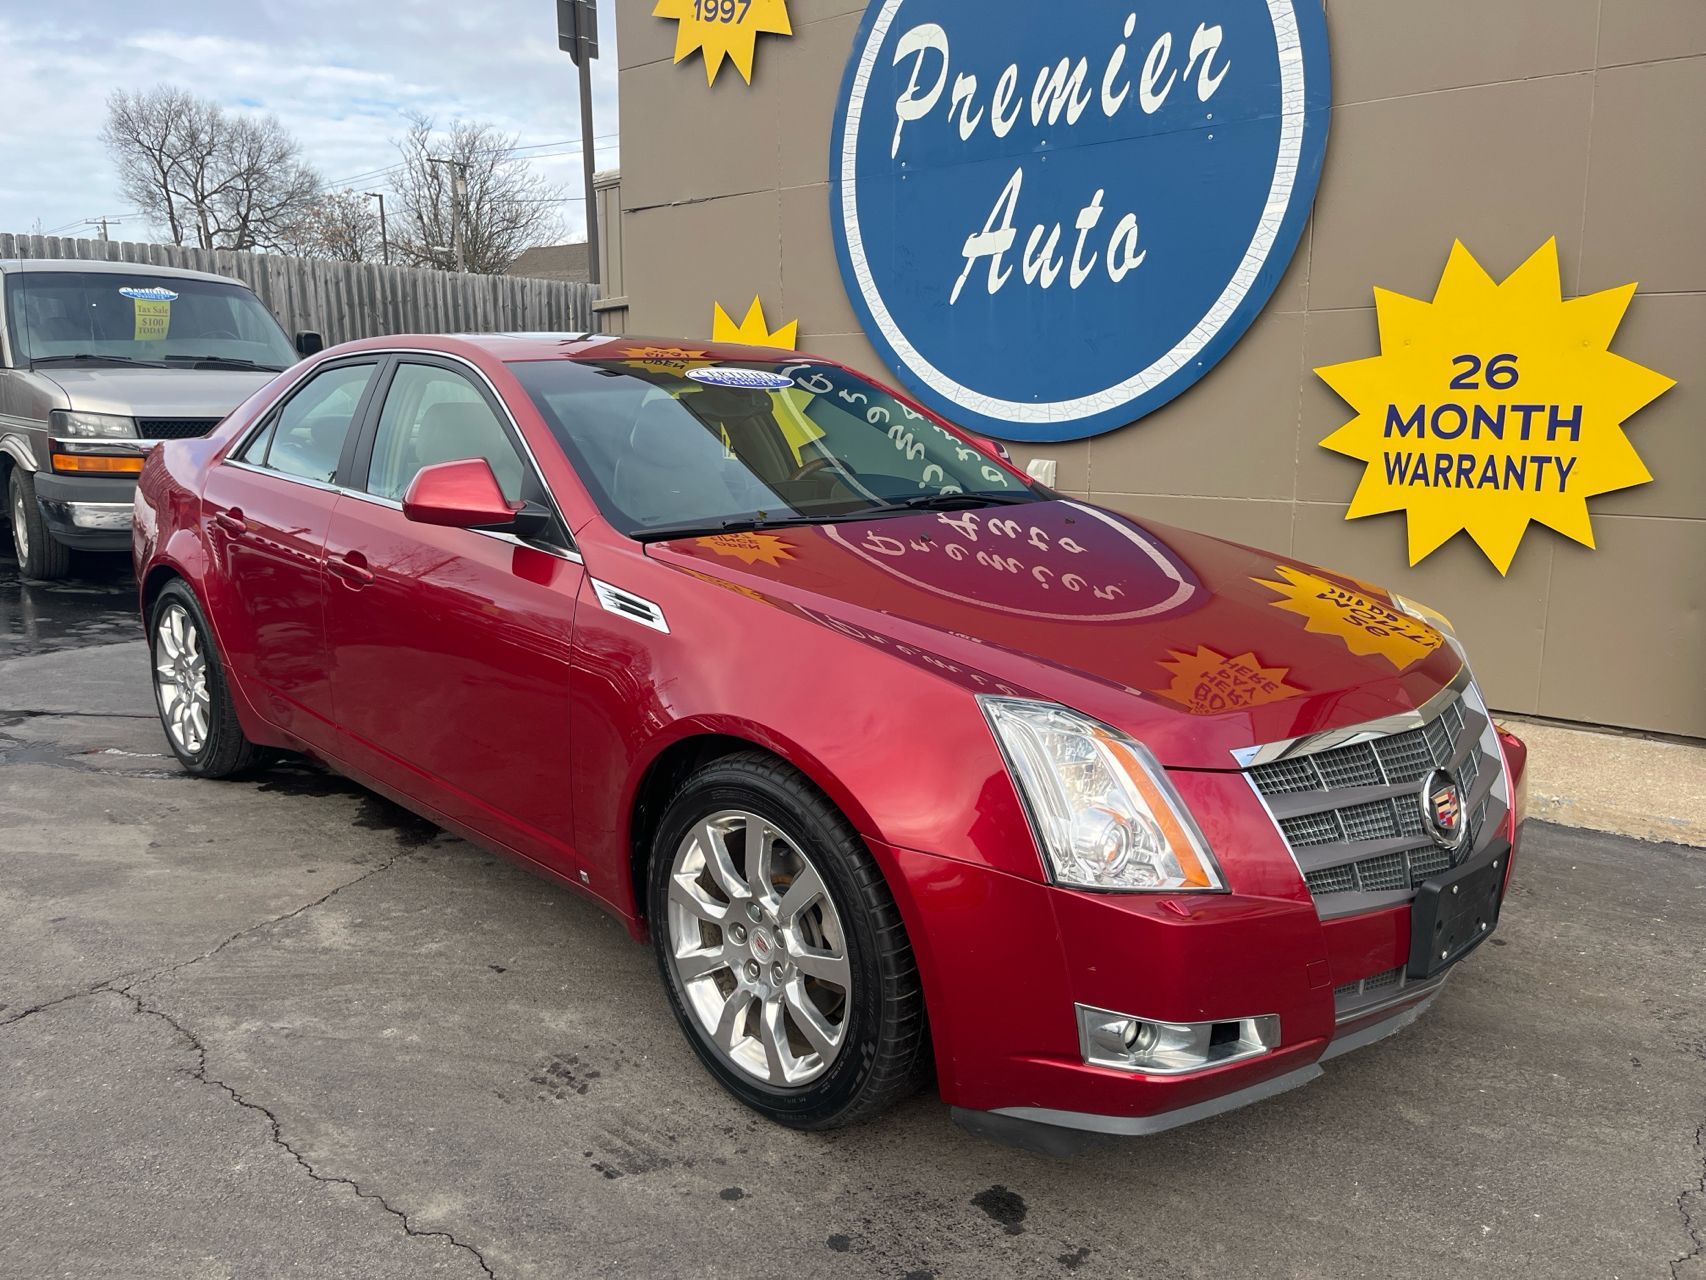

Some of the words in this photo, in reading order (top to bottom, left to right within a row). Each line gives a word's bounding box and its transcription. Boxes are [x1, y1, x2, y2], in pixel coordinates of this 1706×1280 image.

[694, 0, 751, 25] 1997
[891, 12, 1231, 159] Premier
[949, 167, 1147, 305] Auto
[138, 305, 151, 313] Tax
[142, 318, 164, 327] $100
[1449, 353, 1519, 390] 26
[1384, 403, 1583, 441] MONTH
[1384, 451, 1577, 492] WARRANTY
